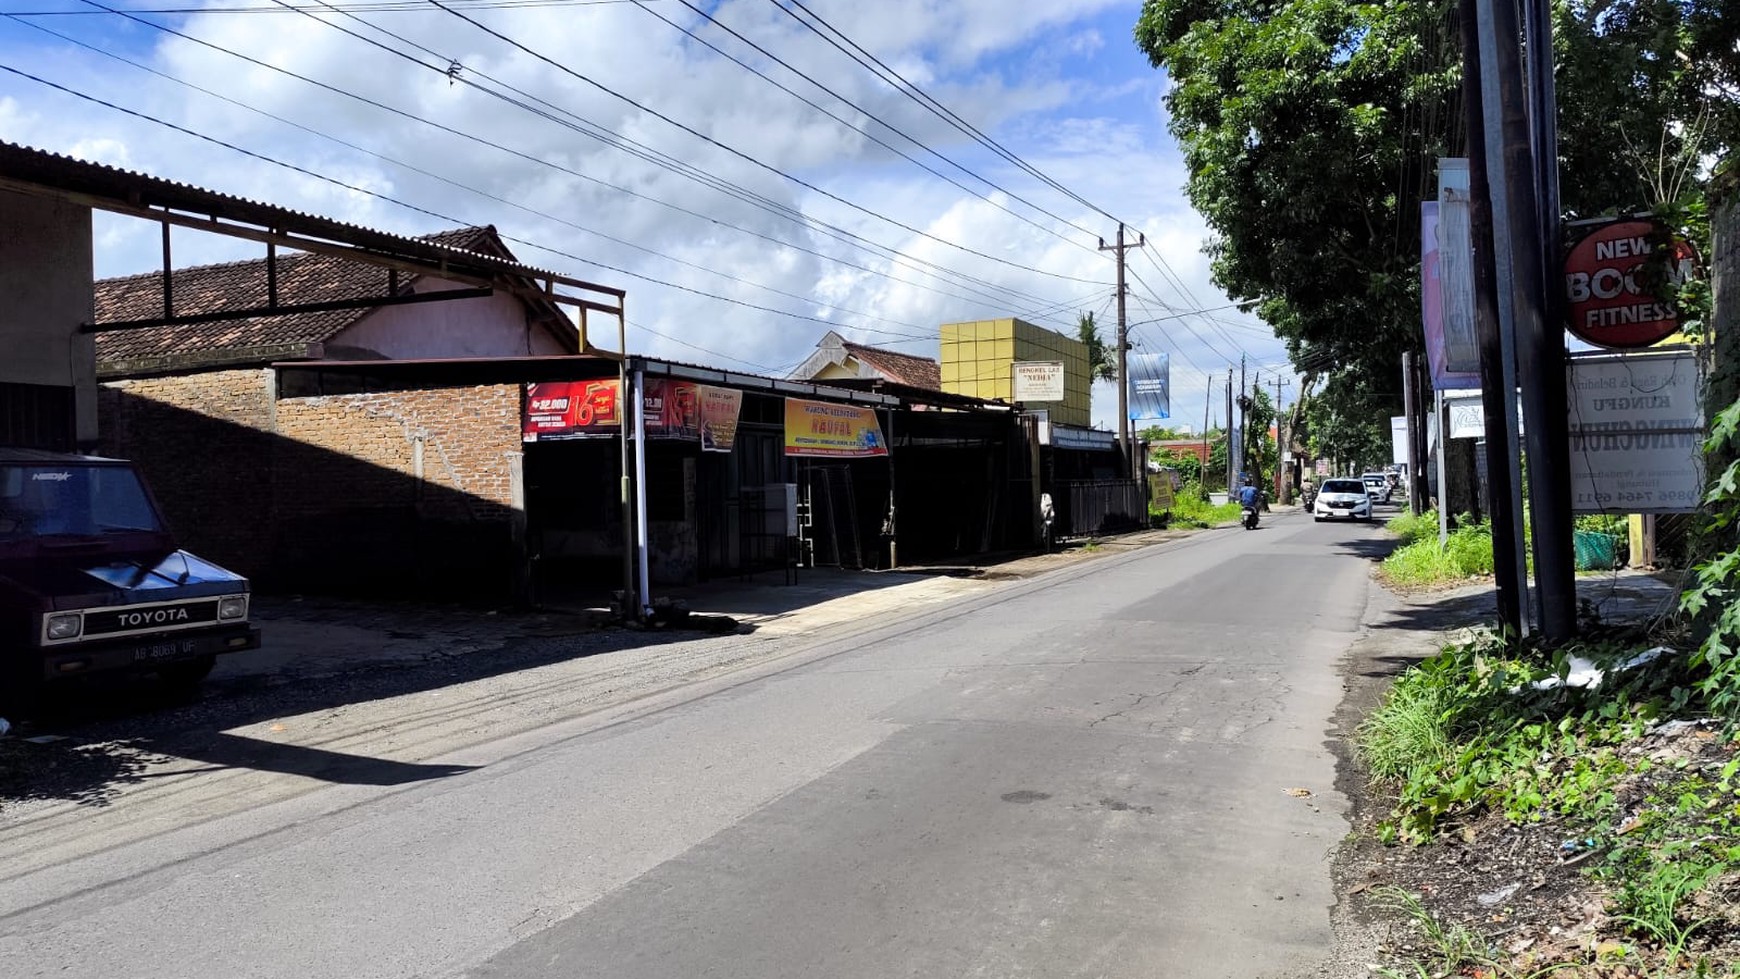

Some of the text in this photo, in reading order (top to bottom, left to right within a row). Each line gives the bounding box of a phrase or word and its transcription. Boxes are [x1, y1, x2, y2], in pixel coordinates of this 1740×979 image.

[1596, 236, 1652, 261] NEW
[1585, 302, 1678, 328] FITNESS
[117, 607, 189, 627] TOYOTA
